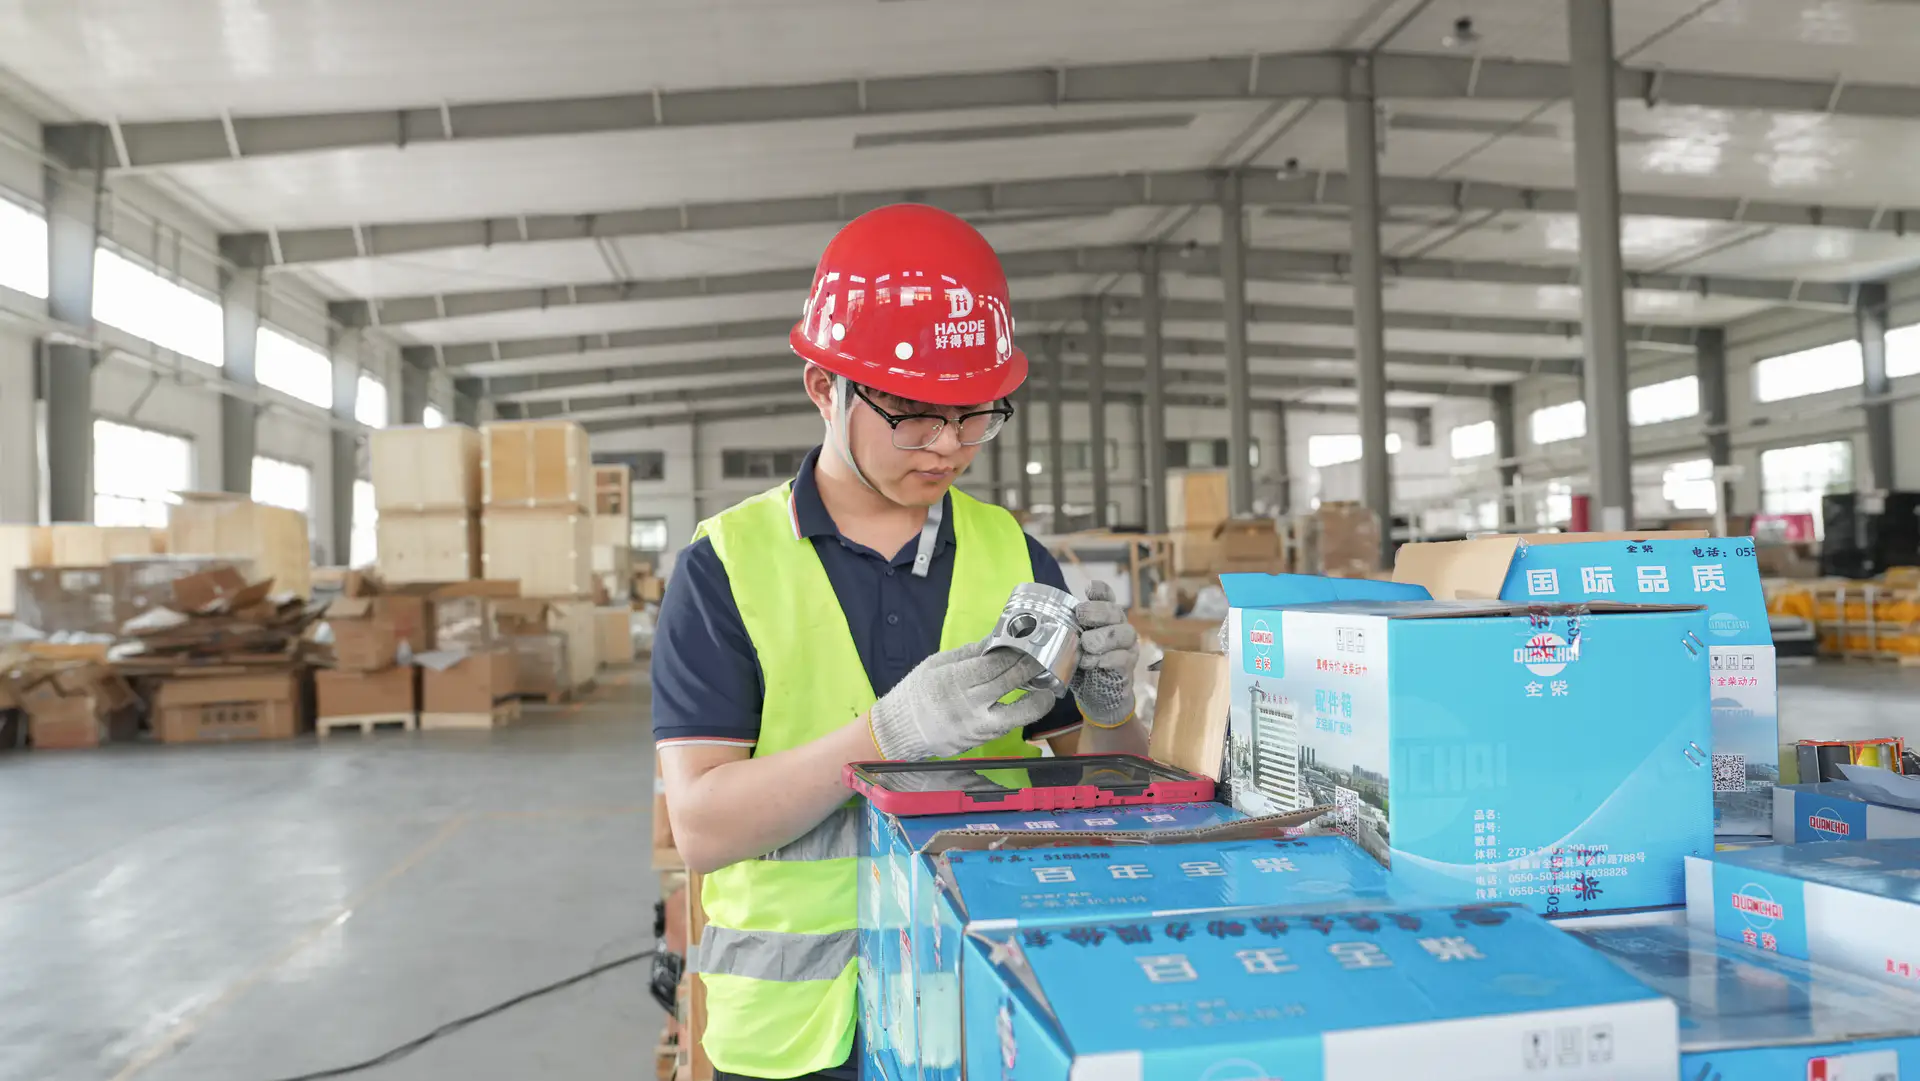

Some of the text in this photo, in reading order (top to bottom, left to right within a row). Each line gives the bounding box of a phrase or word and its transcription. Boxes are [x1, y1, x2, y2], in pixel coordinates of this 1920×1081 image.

[934, 319, 986, 335] HAODE
[1525, 562, 1727, 597] 国际品质
[1513, 647, 1581, 664] QUANCHAI
[1524, 680, 1570, 698] 全柴
[1717, 676, 1758, 687] 全柴动力
[1474, 809, 1501, 821] 品名：
[1809, 815, 1850, 836] QUANCHAI
[1507, 847, 1527, 857] 273
[1031, 856, 1300, 884] 百年全柴
[1731, 893, 1784, 921] QUANCHAI
[1134, 935, 1487, 984] 百年全柴
